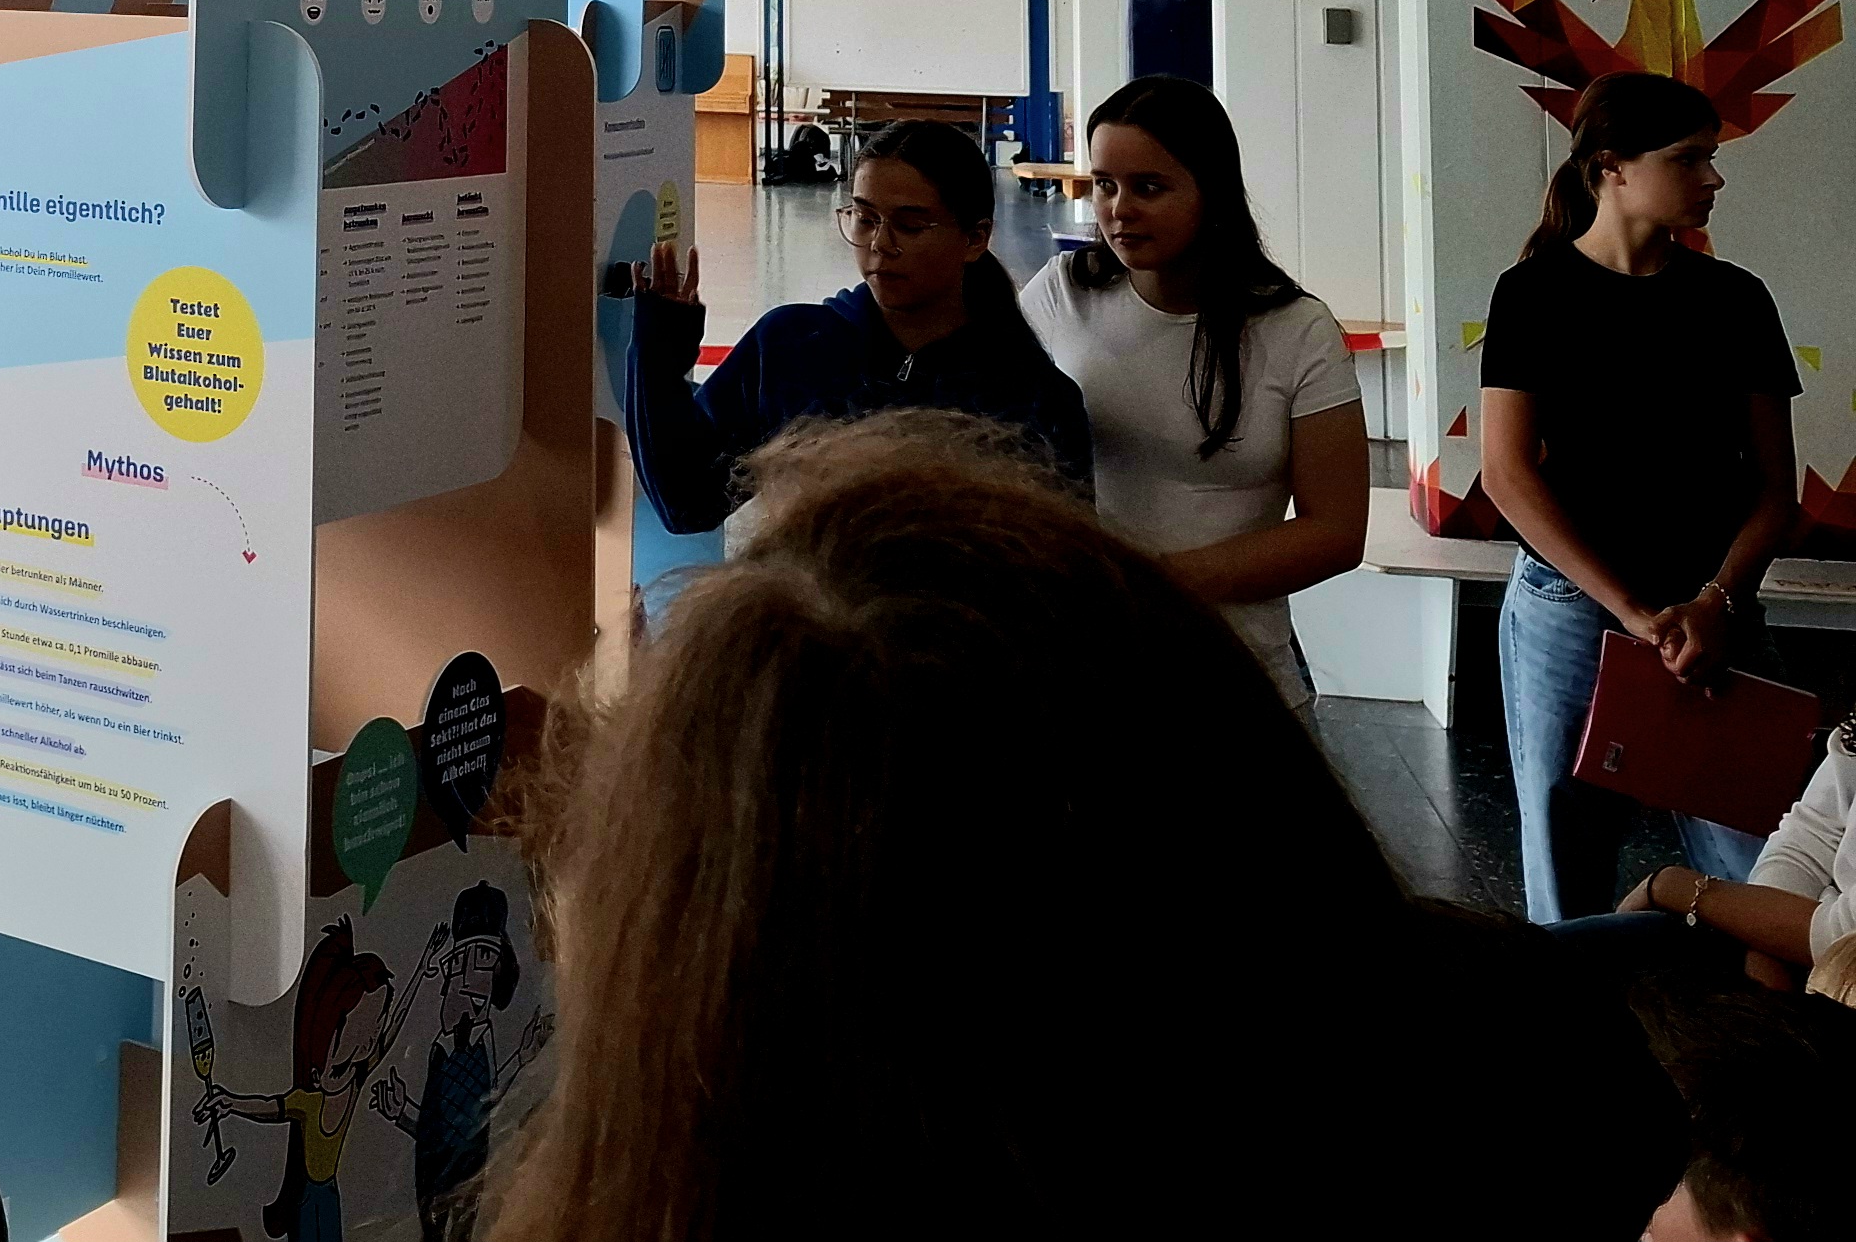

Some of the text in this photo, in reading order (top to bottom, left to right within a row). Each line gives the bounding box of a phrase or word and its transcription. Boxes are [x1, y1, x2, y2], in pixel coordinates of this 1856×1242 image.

[45, 194, 166, 225] eigentlich?
[24, 249, 36, 259] Du
[49, 251, 66, 262] Blut
[27, 265, 46, 276] Dein
[47, 267, 104, 283] Promillewert.
[170, 297, 221, 318] Testet
[177, 322, 213, 341] Euer
[147, 342, 242, 369] Wissen zum
[143, 364, 245, 392] Blutalkohol-
[164, 393, 222, 414] gehalt!
[87, 449, 165, 483] Mythos
[11, 564, 54, 583] betrunken
[55, 574, 67, 586] als
[68, 576, 104, 593] Männer.
[14, 598, 38, 612] durch
[39, 604, 100, 625] Wassertrinken
[102, 616, 167, 639] beschleunigen.
[1, 629, 30, 644] Stunde
[32, 635, 53, 648] etwa
[83, 646, 120, 663] Promille
[121, 655, 163, 672] abbauen.
[17, 664, 34, 676] sich
[35, 668, 57, 681] beim
[58, 673, 88, 689] Tanzen
[89, 683, 153, 704] rausschwitzen.
[1, 725, 38, 743] schneller
[39, 736, 72, 753] Alkohol
[64, 708, 76, 720] als
[77, 713, 101, 726] wenn
[103, 717, 116, 729] Du
[117, 720, 131, 733] ein
[133, 724, 151, 738] Bier
[153, 729, 185, 745] trinkst.
[78, 780, 92, 791] um
[94, 781, 106, 794] bis
[108, 787, 118, 797] zu
[120, 788, 132, 801] 50
[133, 792, 169, 810] Prozent.
[31, 799, 55, 815] bleibt
[57, 806, 84, 823] länger
[85, 815, 127, 834] nüchtern.
